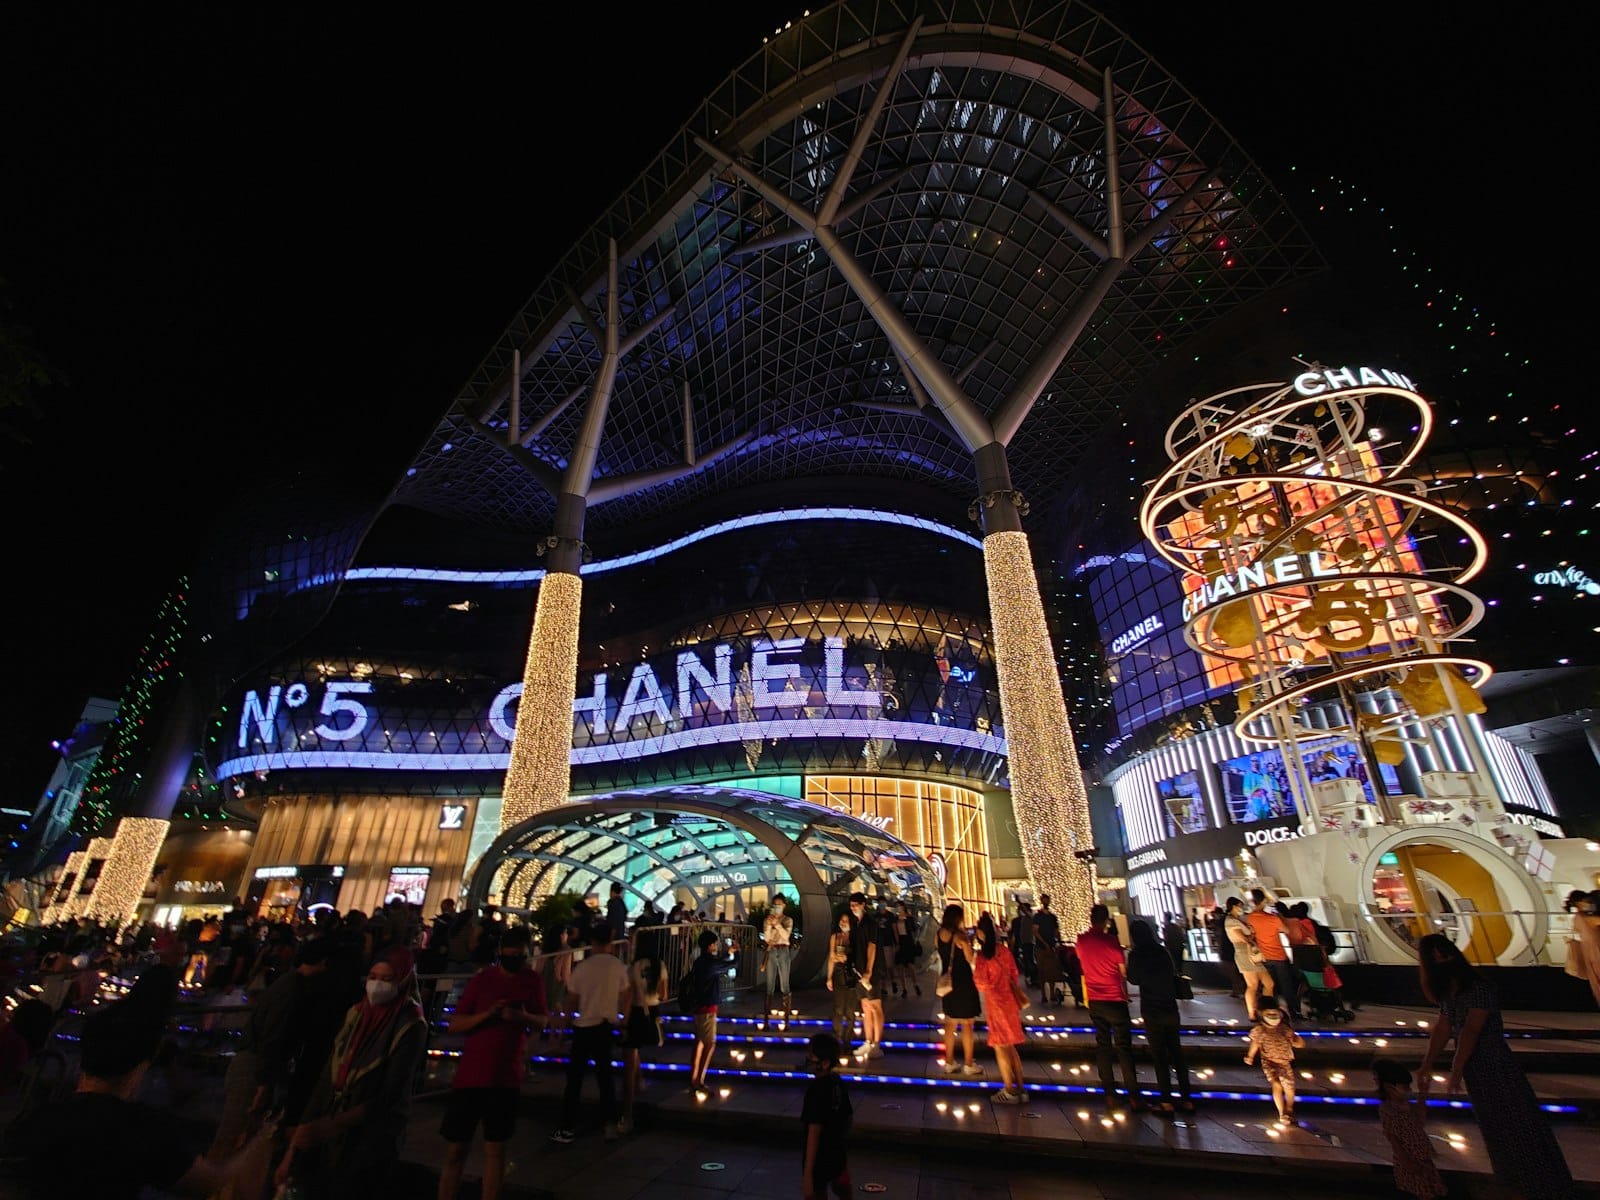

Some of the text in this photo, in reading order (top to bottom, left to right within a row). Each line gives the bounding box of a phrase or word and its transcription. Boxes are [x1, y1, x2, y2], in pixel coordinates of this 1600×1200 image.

[1182, 551, 1341, 623] CHANEL
[1112, 615, 1163, 653] CHANEL
[489, 636, 881, 742] CHANEL
